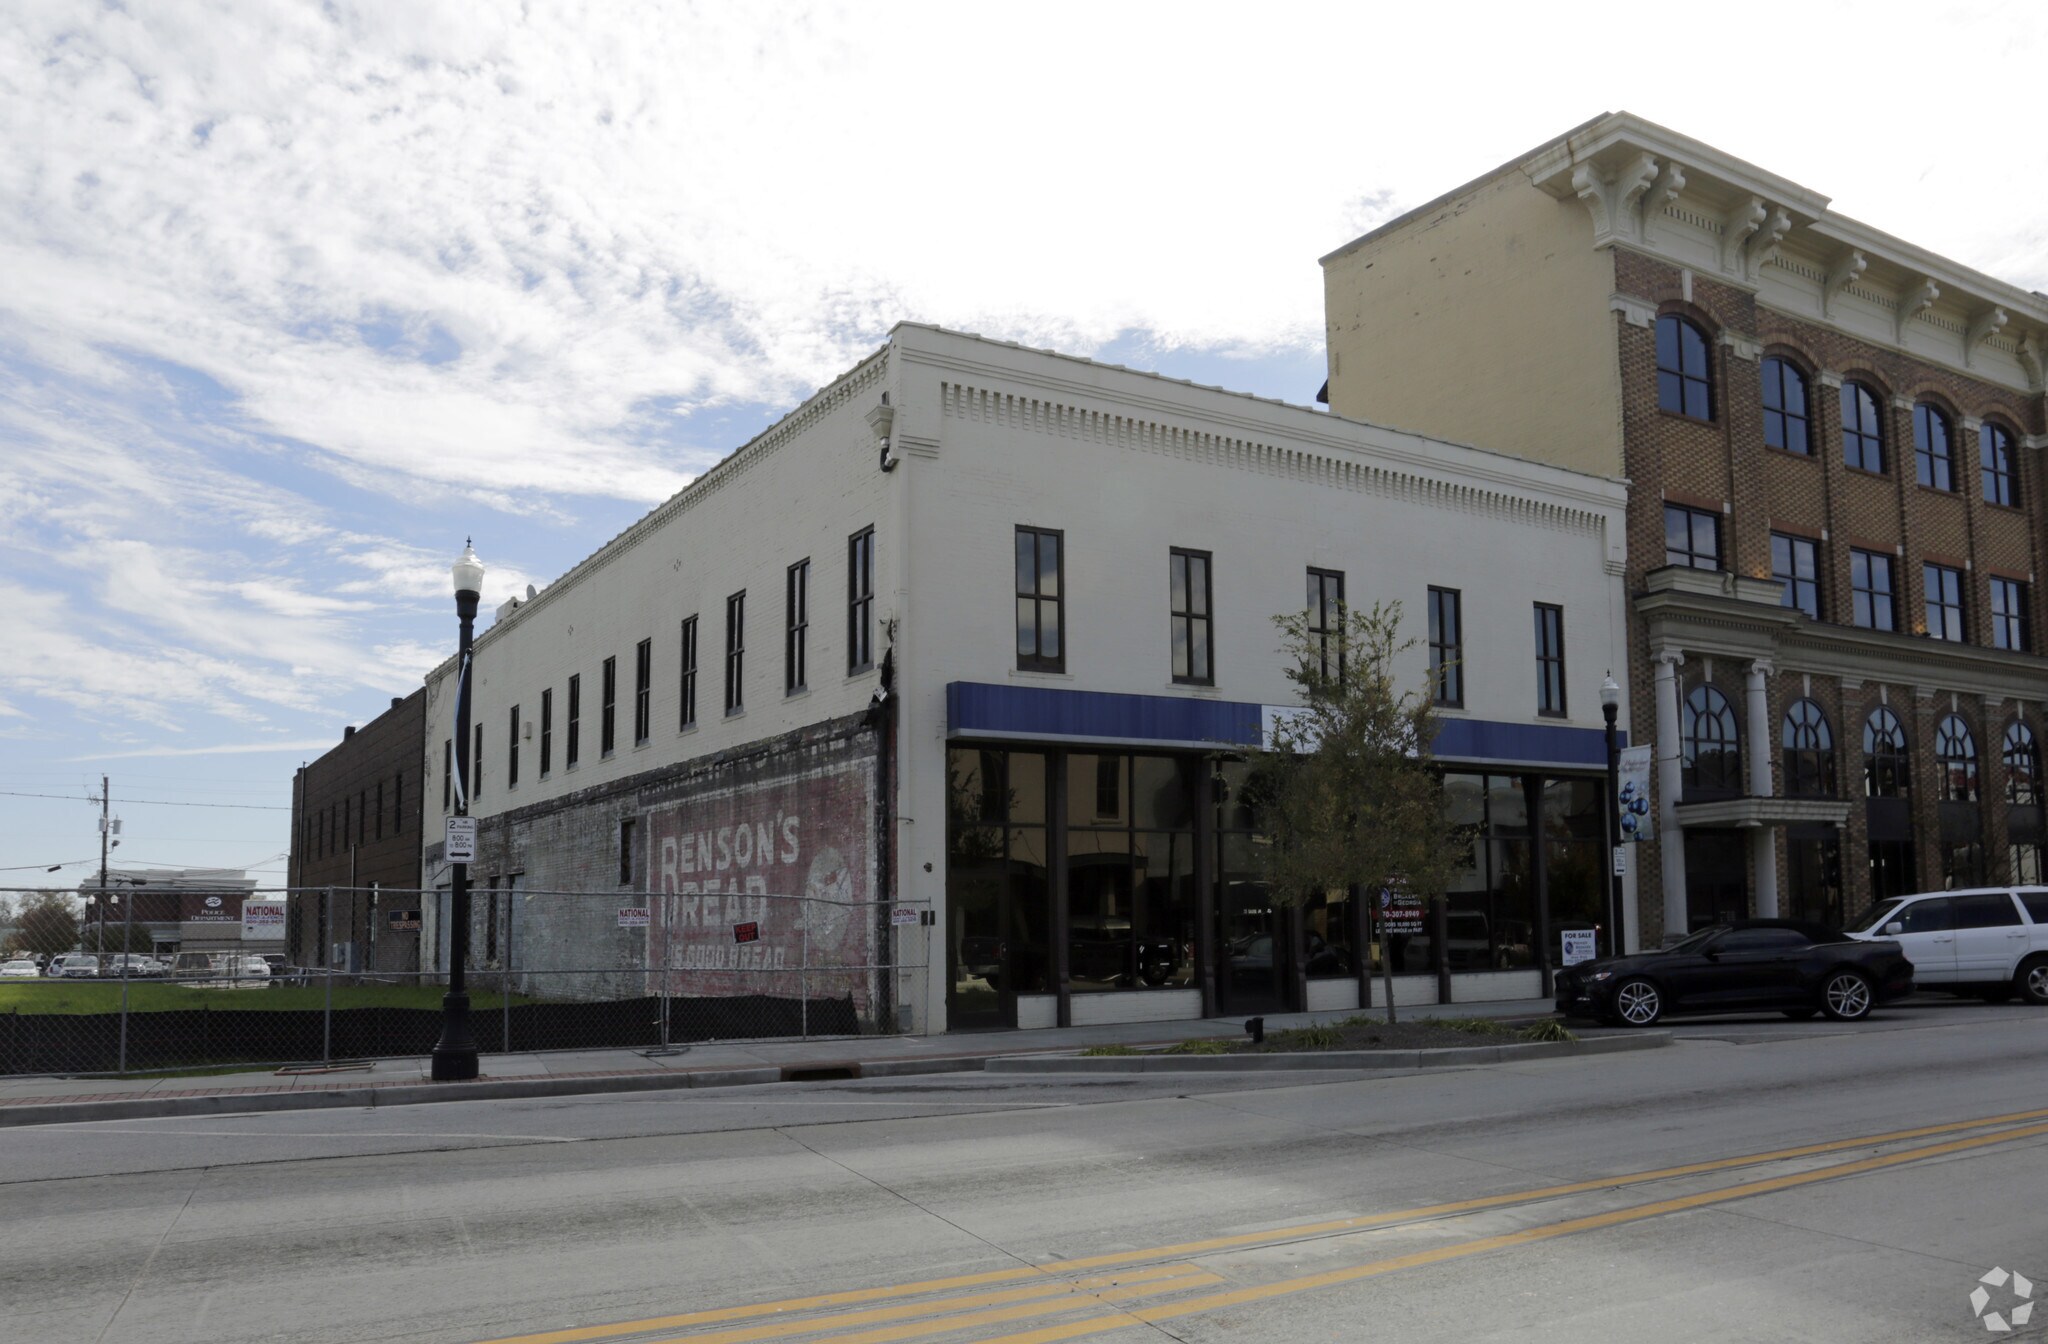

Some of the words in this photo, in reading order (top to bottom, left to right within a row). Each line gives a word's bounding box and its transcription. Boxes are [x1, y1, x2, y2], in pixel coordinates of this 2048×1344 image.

[449, 820, 456, 829] 2
[246, 906, 284, 916] NATIONAL
[620, 909, 649, 918] NATIONAL
[893, 908, 917, 917] NATIONAL
[736, 923, 756, 933] KEEP
[739, 932, 755, 941] OUT
